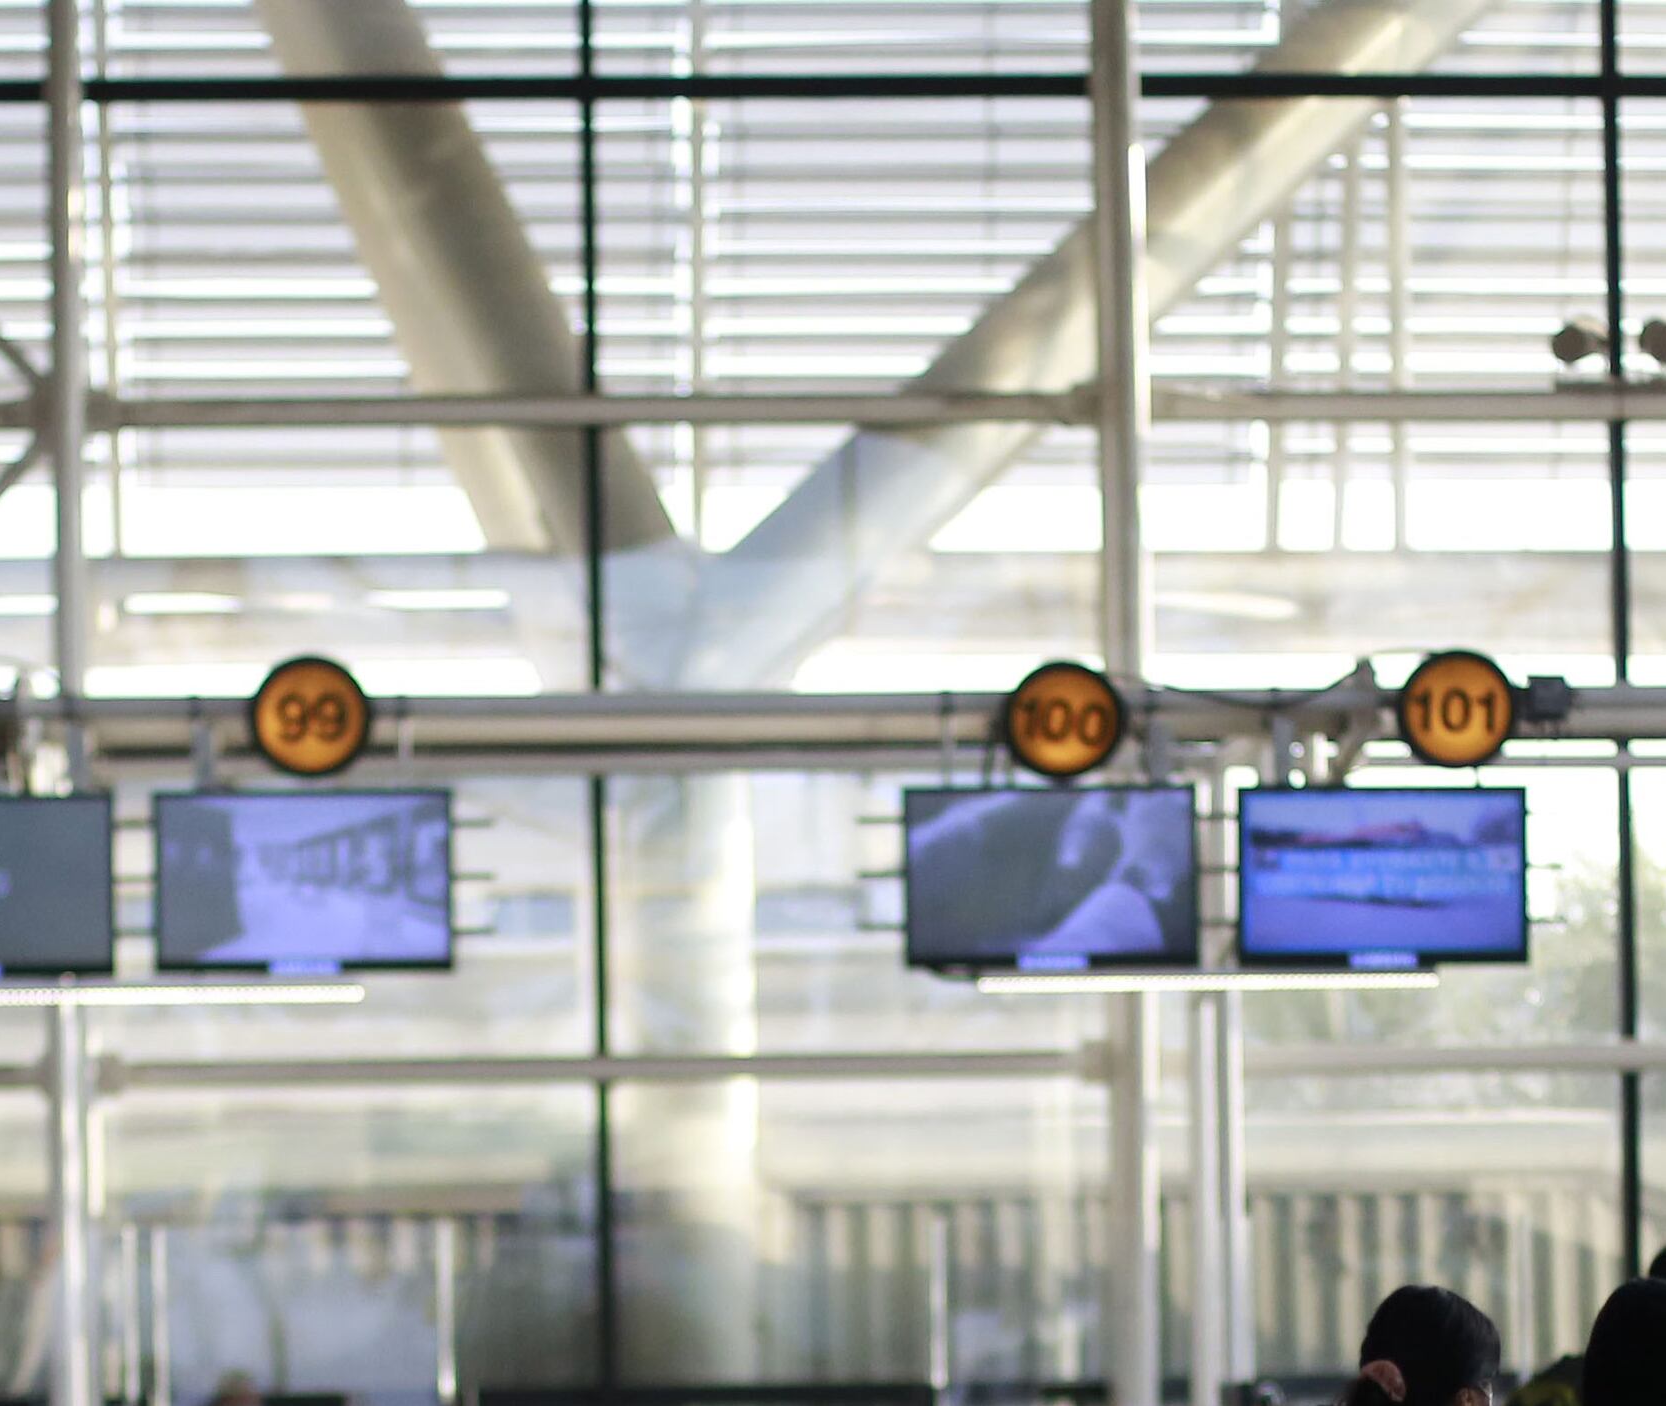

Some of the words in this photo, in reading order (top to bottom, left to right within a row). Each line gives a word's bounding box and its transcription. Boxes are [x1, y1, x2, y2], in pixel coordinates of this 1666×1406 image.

[276, 693, 351, 742] 99
[1019, 698, 1111, 744] 100
[1413, 685, 1501, 735] 101
